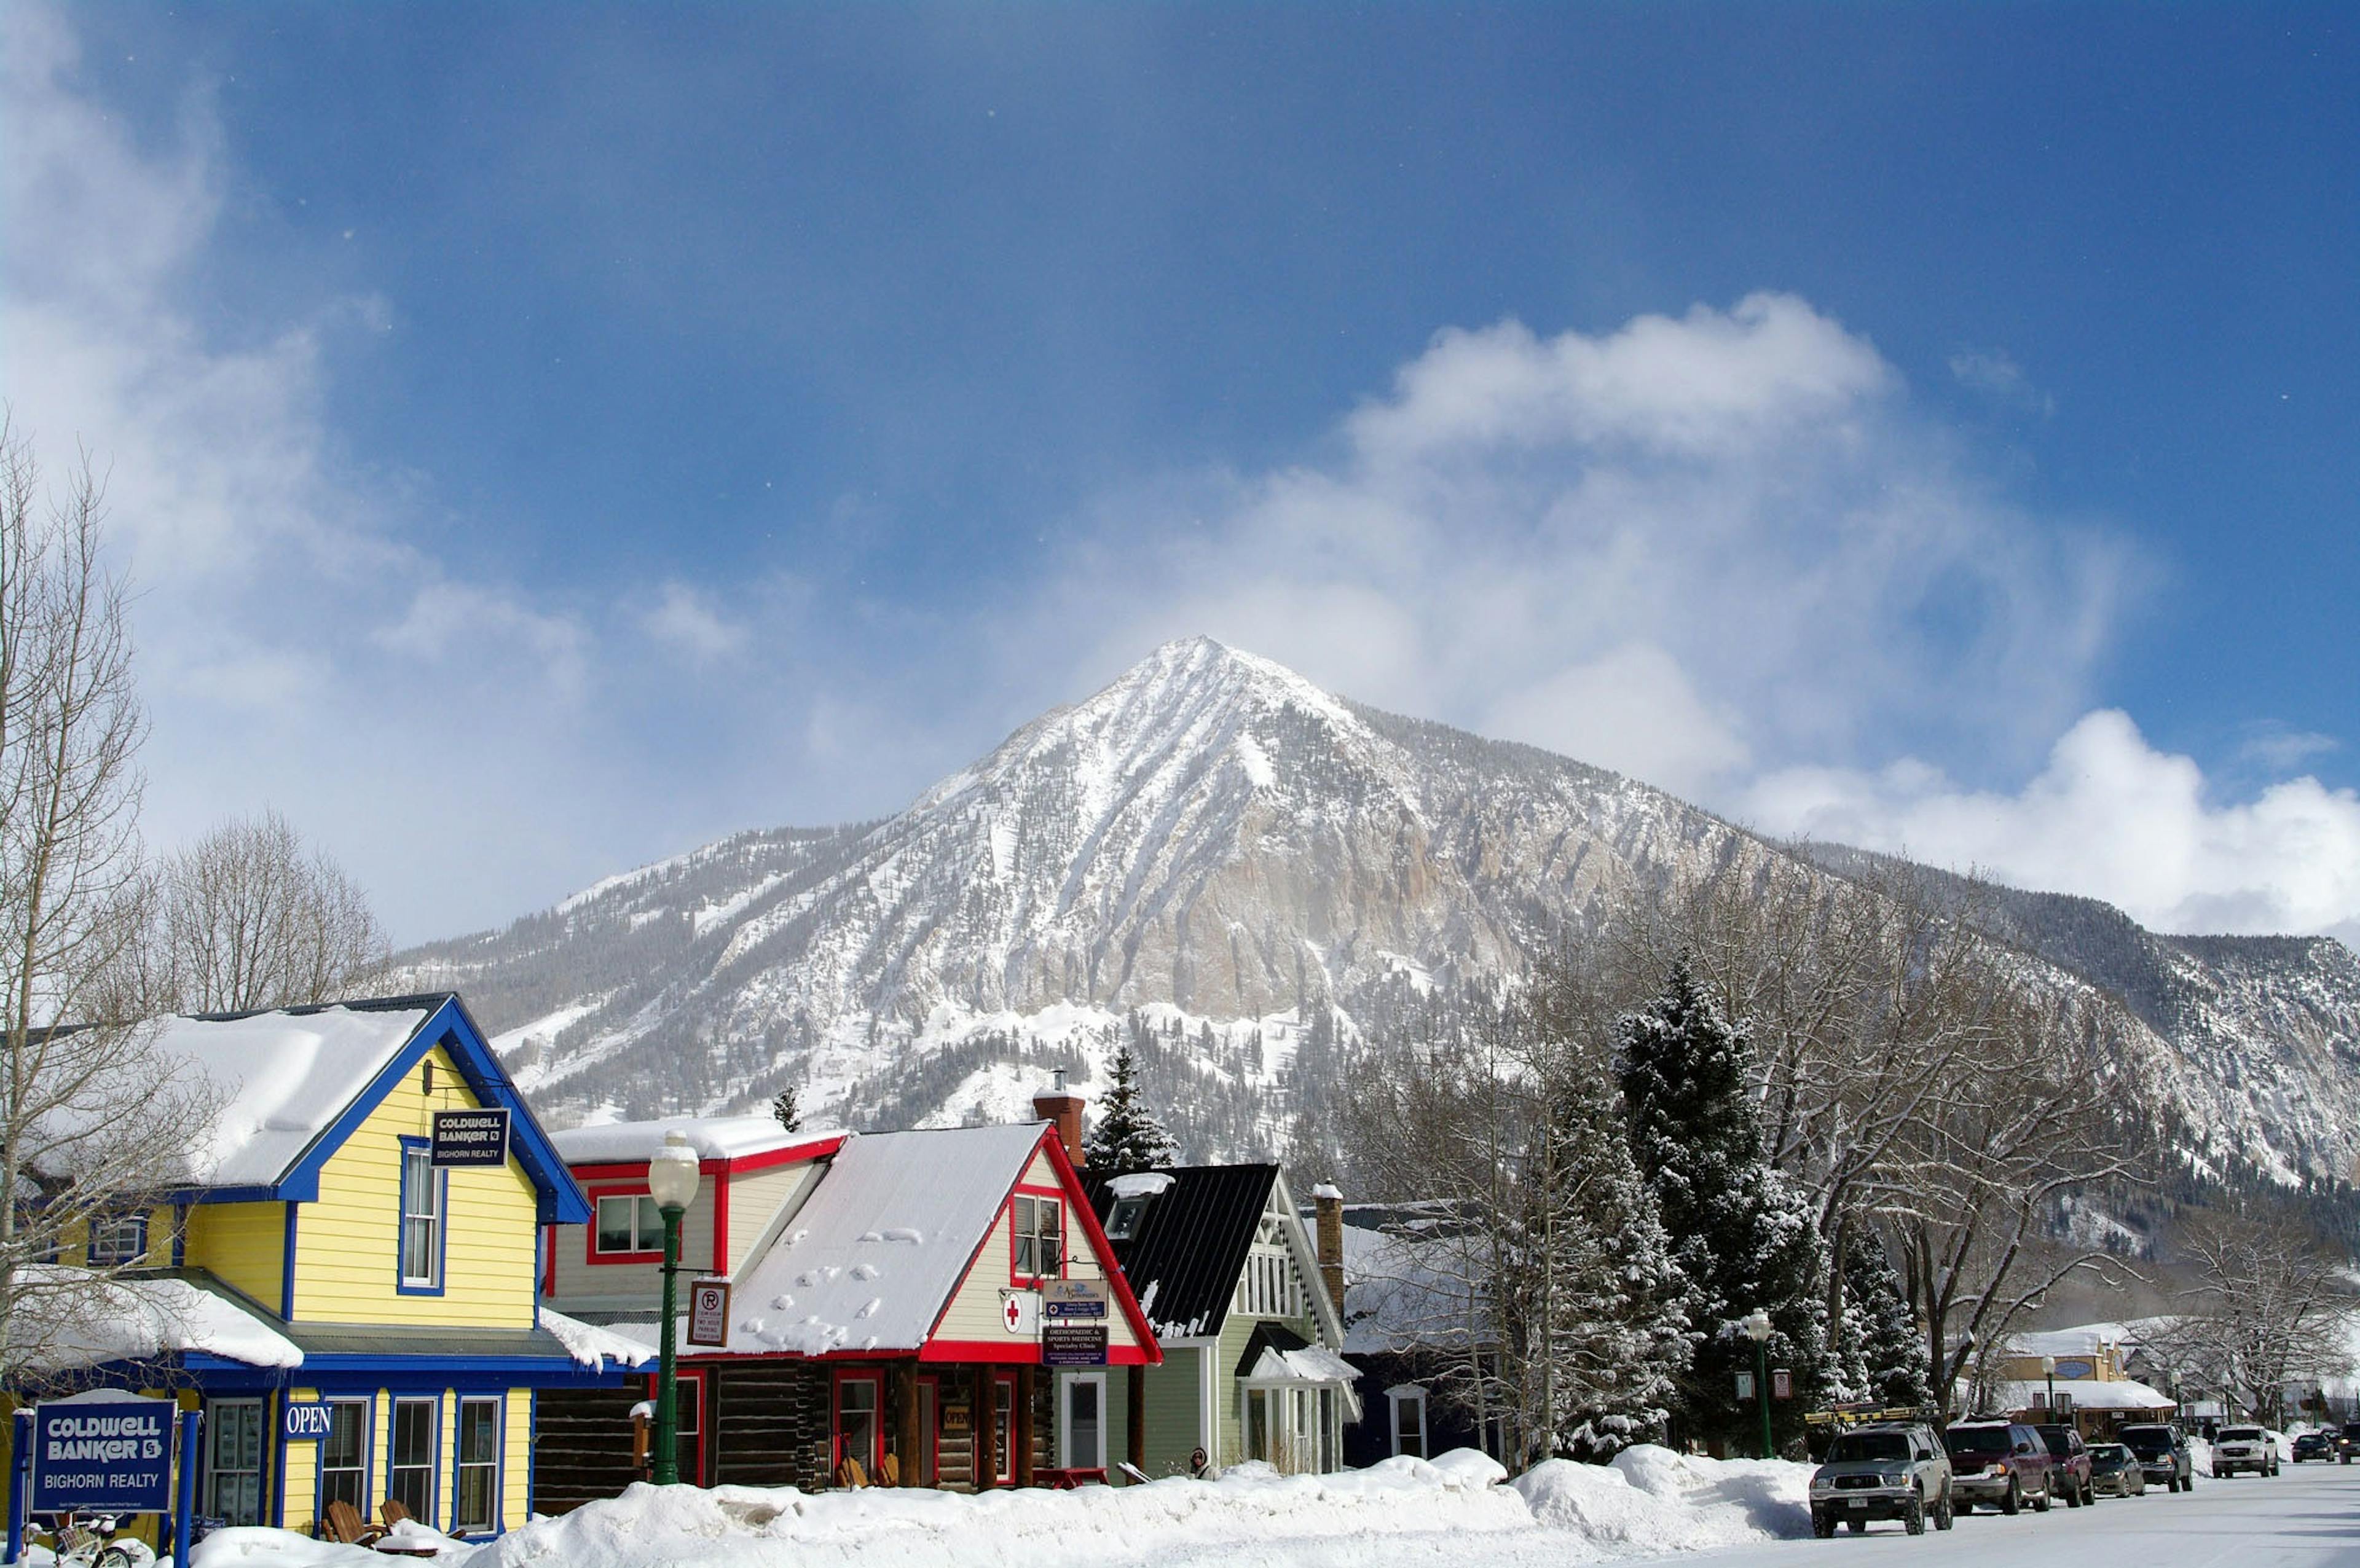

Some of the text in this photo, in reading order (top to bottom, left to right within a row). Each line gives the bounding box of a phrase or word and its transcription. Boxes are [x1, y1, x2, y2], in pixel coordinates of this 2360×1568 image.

[437, 1150, 469, 1158] BIGHORN
[287, 1406, 332, 1433] OPEN
[946, 1413, 970, 1424] OPEN
[44, 1473, 159, 1489] BIGHORN REALTY
